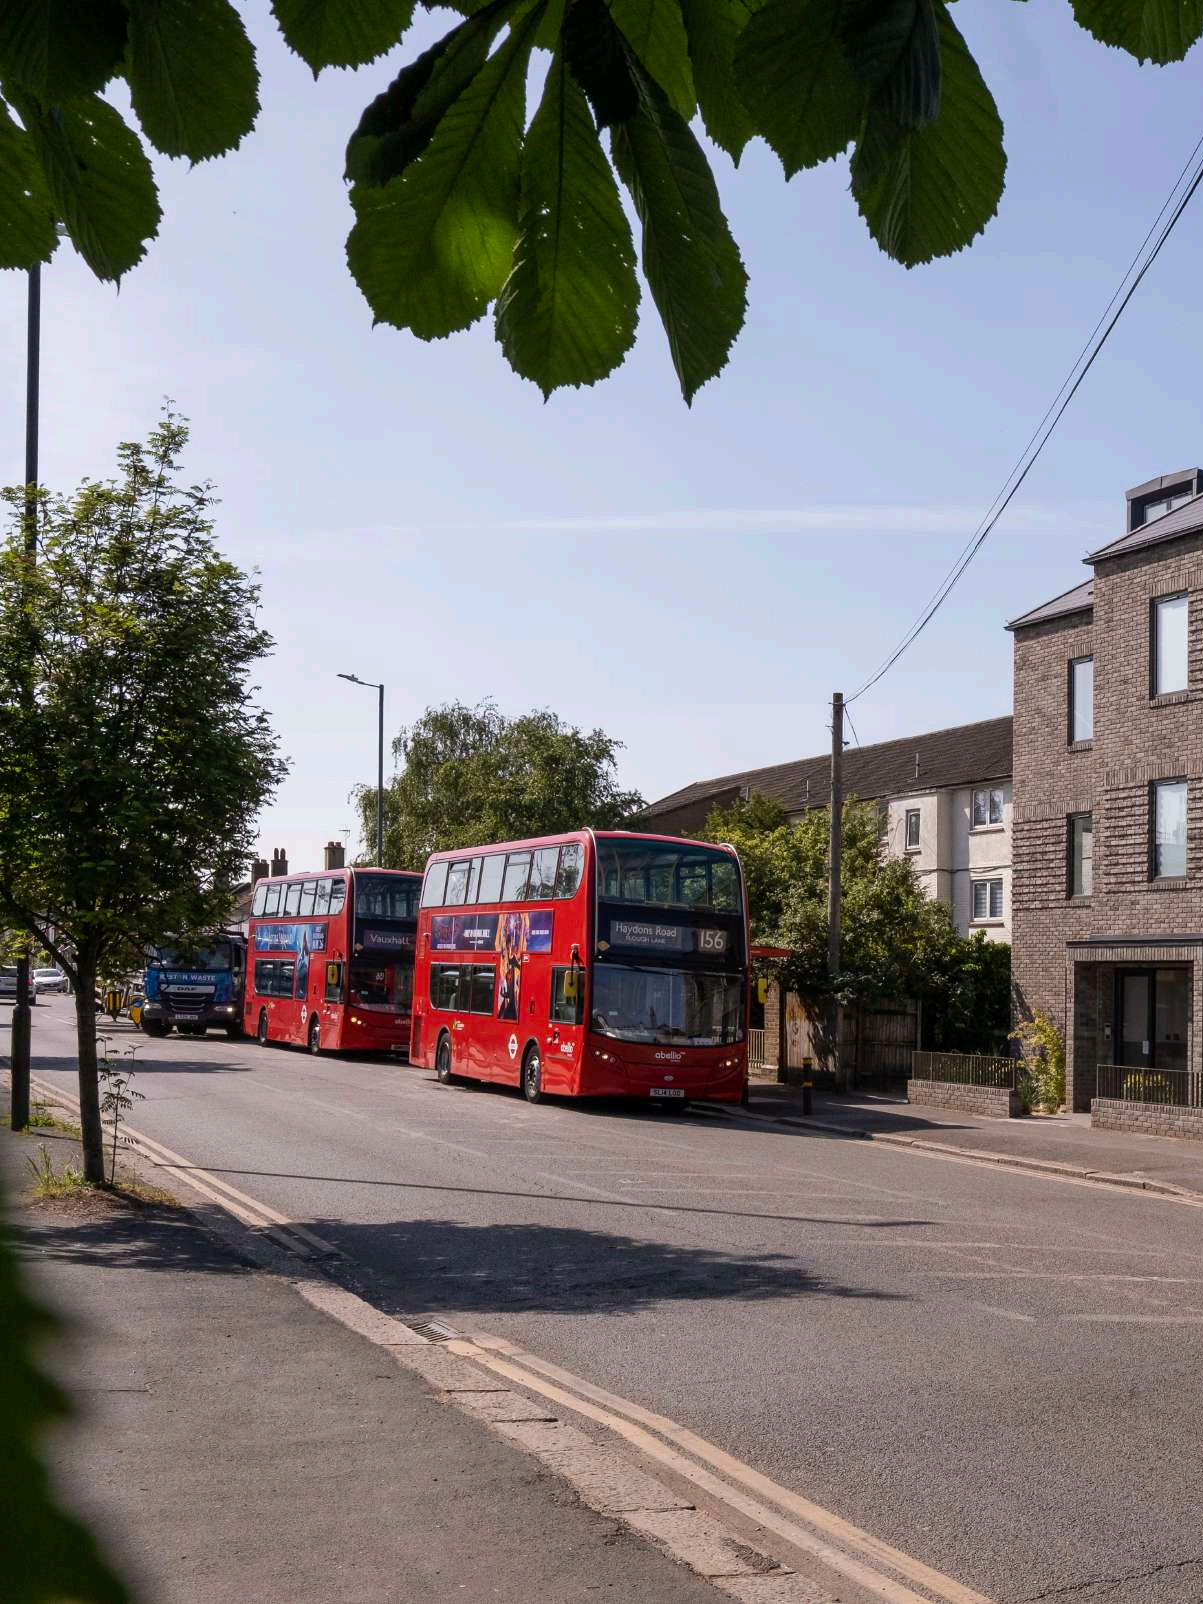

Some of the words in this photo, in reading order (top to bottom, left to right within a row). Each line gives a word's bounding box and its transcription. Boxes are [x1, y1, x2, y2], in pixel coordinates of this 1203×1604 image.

[615, 922, 653, 936] Haydons
[655, 926, 677, 937] Road
[370, 933, 410, 945] Vauxhall
[700, 930, 724, 949] 156
[655, 1050, 682, 1060] abellio
